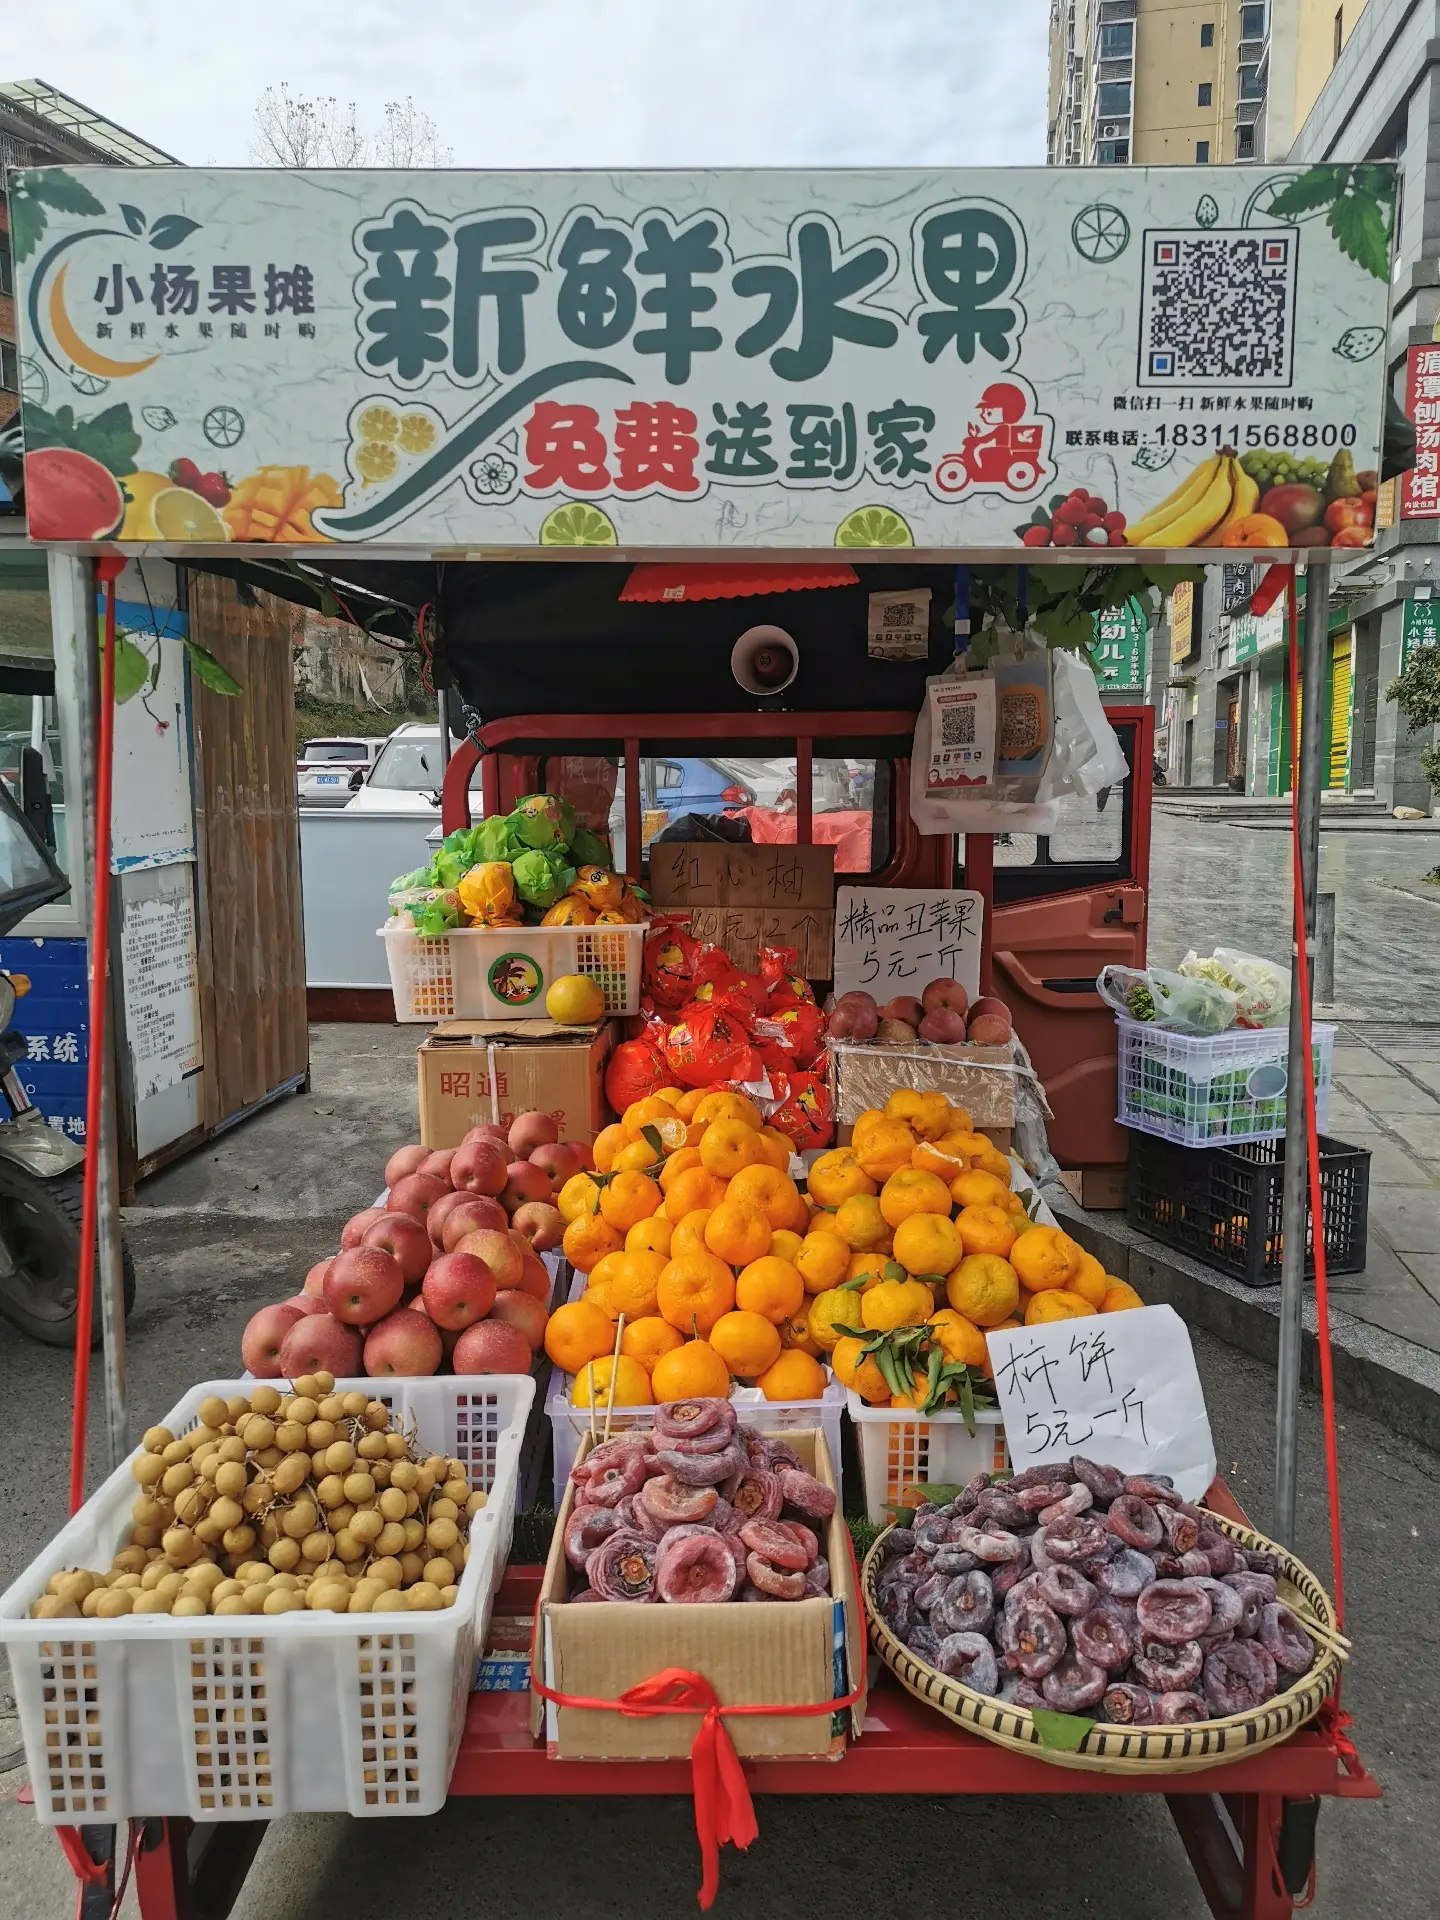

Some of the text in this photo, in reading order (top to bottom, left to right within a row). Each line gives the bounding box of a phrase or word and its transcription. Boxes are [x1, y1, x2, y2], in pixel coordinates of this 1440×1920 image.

[94, 263, 316, 317] 小杨果摊
[361, 207, 1018, 385] 新鲜水果
[95, 321, 317, 340] 新鲜水果随时购
[1113, 395, 1314, 412] 微信扫一扫 新鲜水果随时购
[524, 399, 936, 493] 免费送到家
[671, 847, 805, 900] 红心柚
[839, 898, 979, 945] 精品丑苹果
[859, 943, 964, 984] 5元一斤
[26, 1032, 79, 1062] 系统
[440, 1072, 510, 1098] 昭通
[997, 1330, 1115, 1405] 柿饼
[1026, 1388, 1149, 1454] 5元一斤
